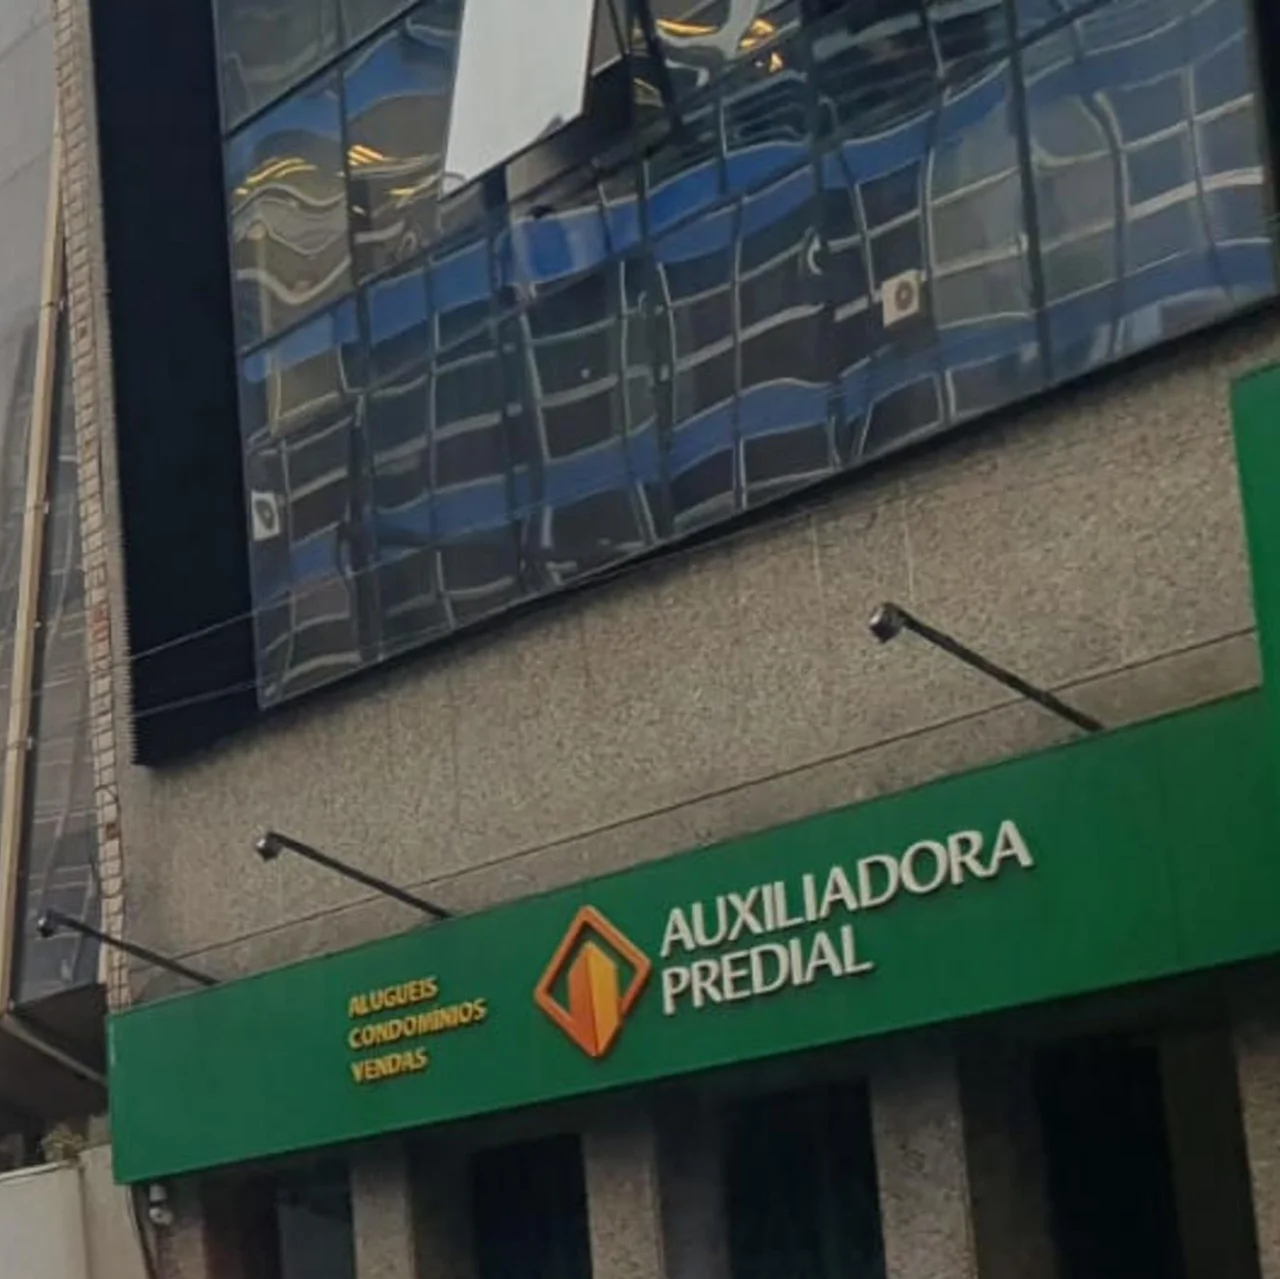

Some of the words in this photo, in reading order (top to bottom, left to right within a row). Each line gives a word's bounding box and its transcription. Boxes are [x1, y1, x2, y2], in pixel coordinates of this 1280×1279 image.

[659, 818, 1034, 958] AUXILIADORA
[660, 924, 874, 1016] PREDIAL
[350, 1046, 429, 1083] VENDAS
